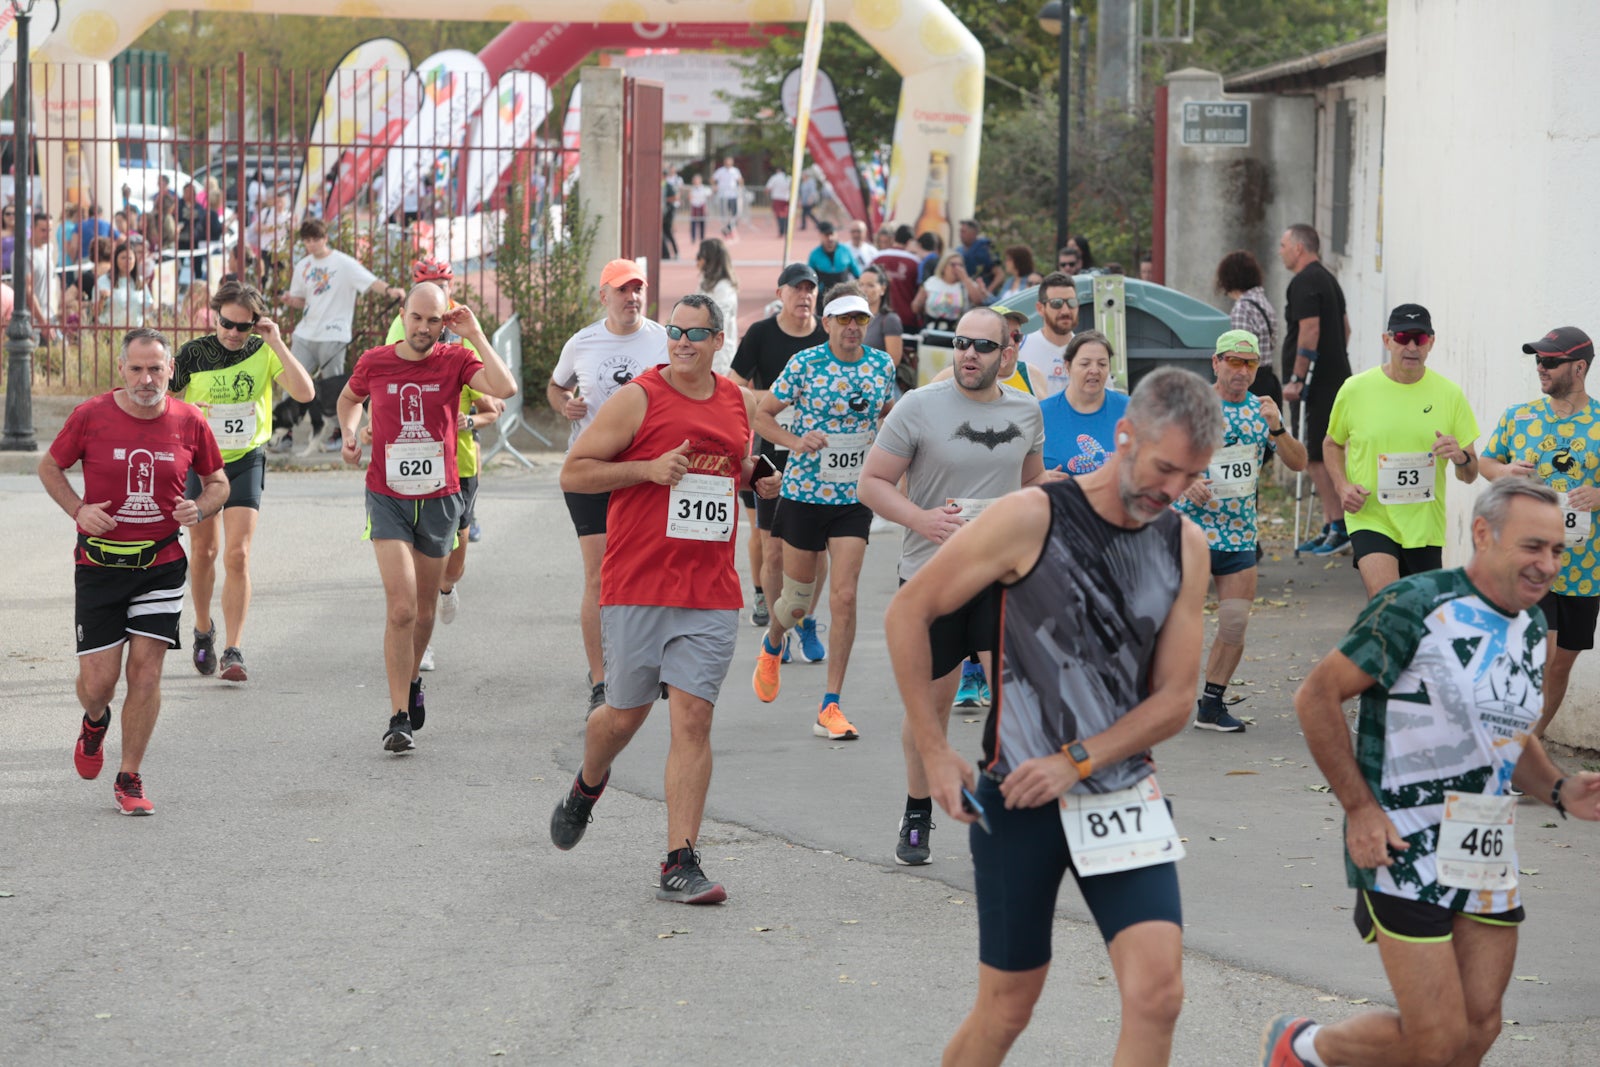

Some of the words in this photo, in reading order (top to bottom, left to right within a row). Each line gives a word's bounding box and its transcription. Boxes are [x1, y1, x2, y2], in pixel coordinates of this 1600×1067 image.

[1205, 105, 1243, 117] CALLE
[213, 375, 226, 386] XI
[224, 418, 244, 434] 52
[399, 459, 432, 476] 620
[828, 450, 865, 468] 3051
[1221, 462, 1252, 480] 789
[1397, 469, 1419, 486] 53
[677, 498, 728, 522] 3105
[1087, 806, 1143, 838] 817
[1460, 827, 1504, 857] 466
